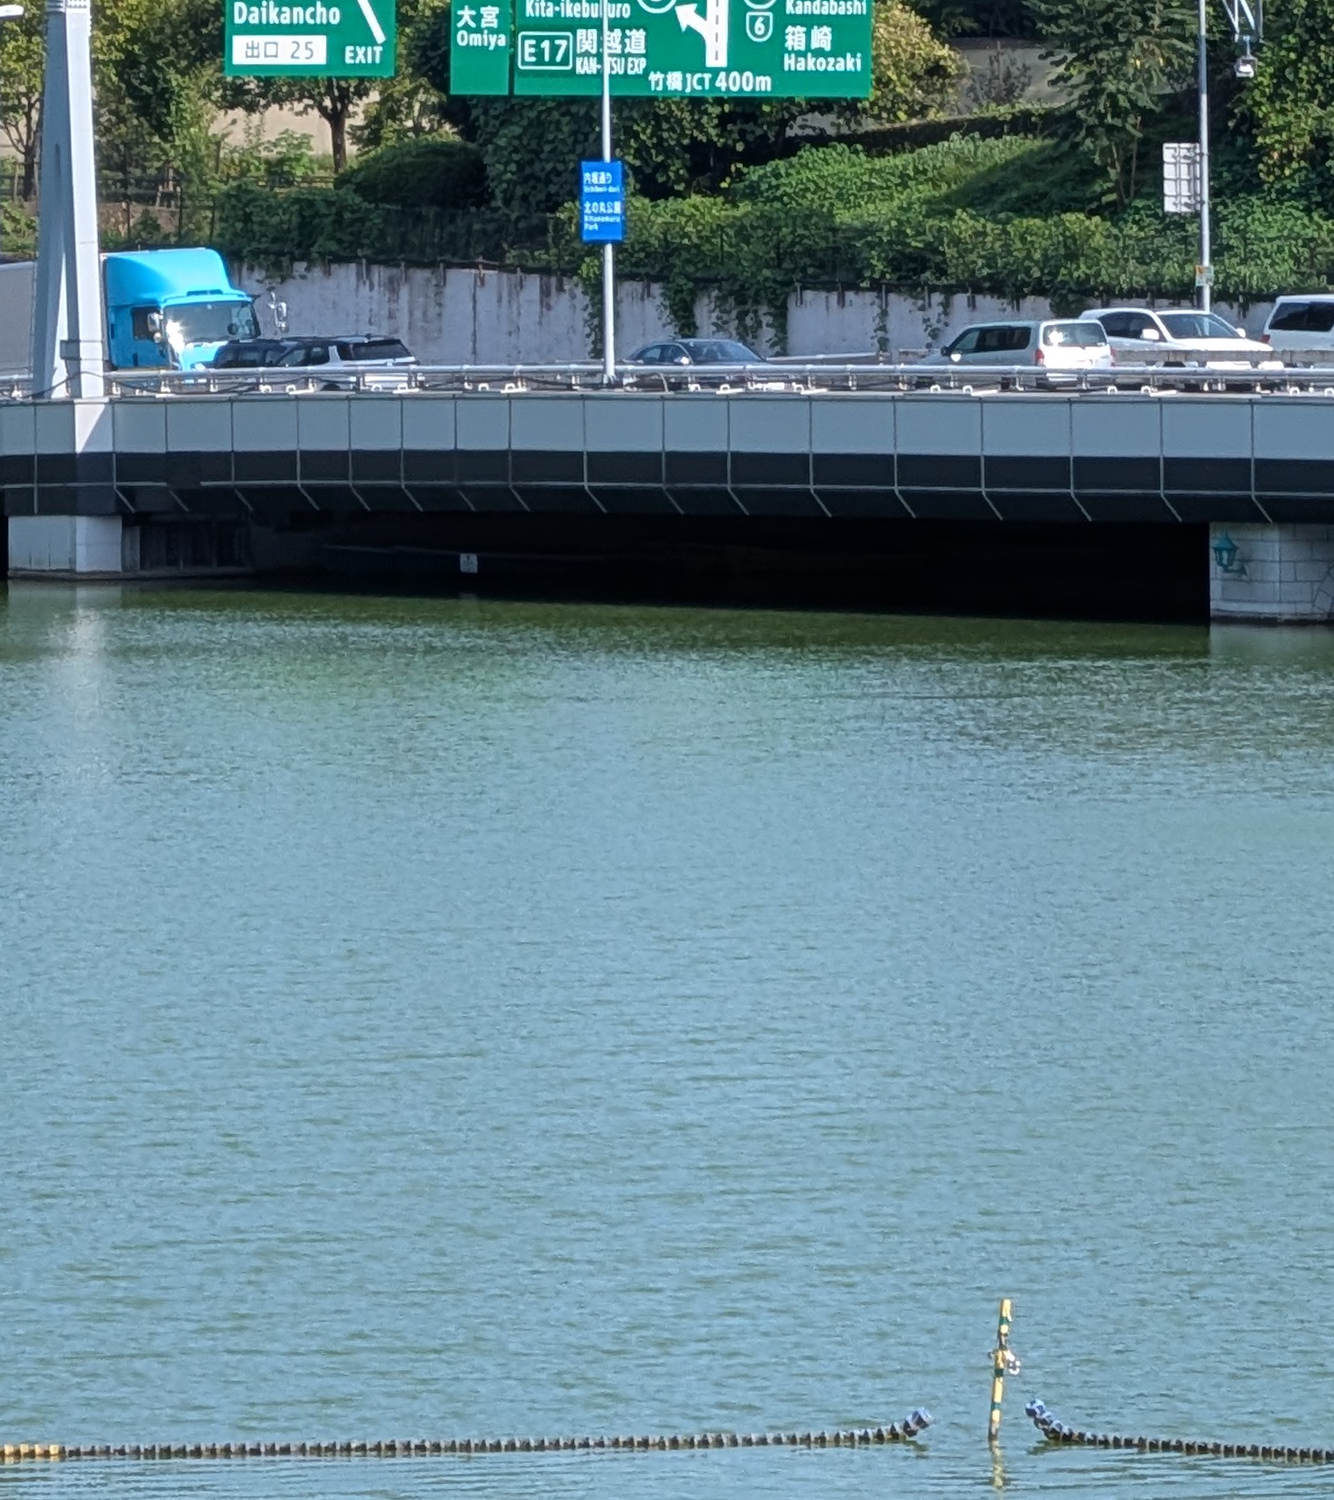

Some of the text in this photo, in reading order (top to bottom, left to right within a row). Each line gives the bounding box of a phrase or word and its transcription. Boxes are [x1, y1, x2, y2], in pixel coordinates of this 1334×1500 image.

[234, 0, 341, 25] Daikancho
[456, 5, 500, 29] 大宮
[754, 16, 766, 36] 6
[456, 30, 507, 50] Omiya
[784, 25, 833, 51] 箱崎
[245, 40, 315, 60] 出口 25
[344, 45, 383, 64] EXIT
[524, 39, 568, 62] E17
[575, 57, 647, 75] KAN-TSU EXP
[784, 52, 862, 72] Hakozaki
[648, 71, 772, 92] 竹橋JCT 400m
